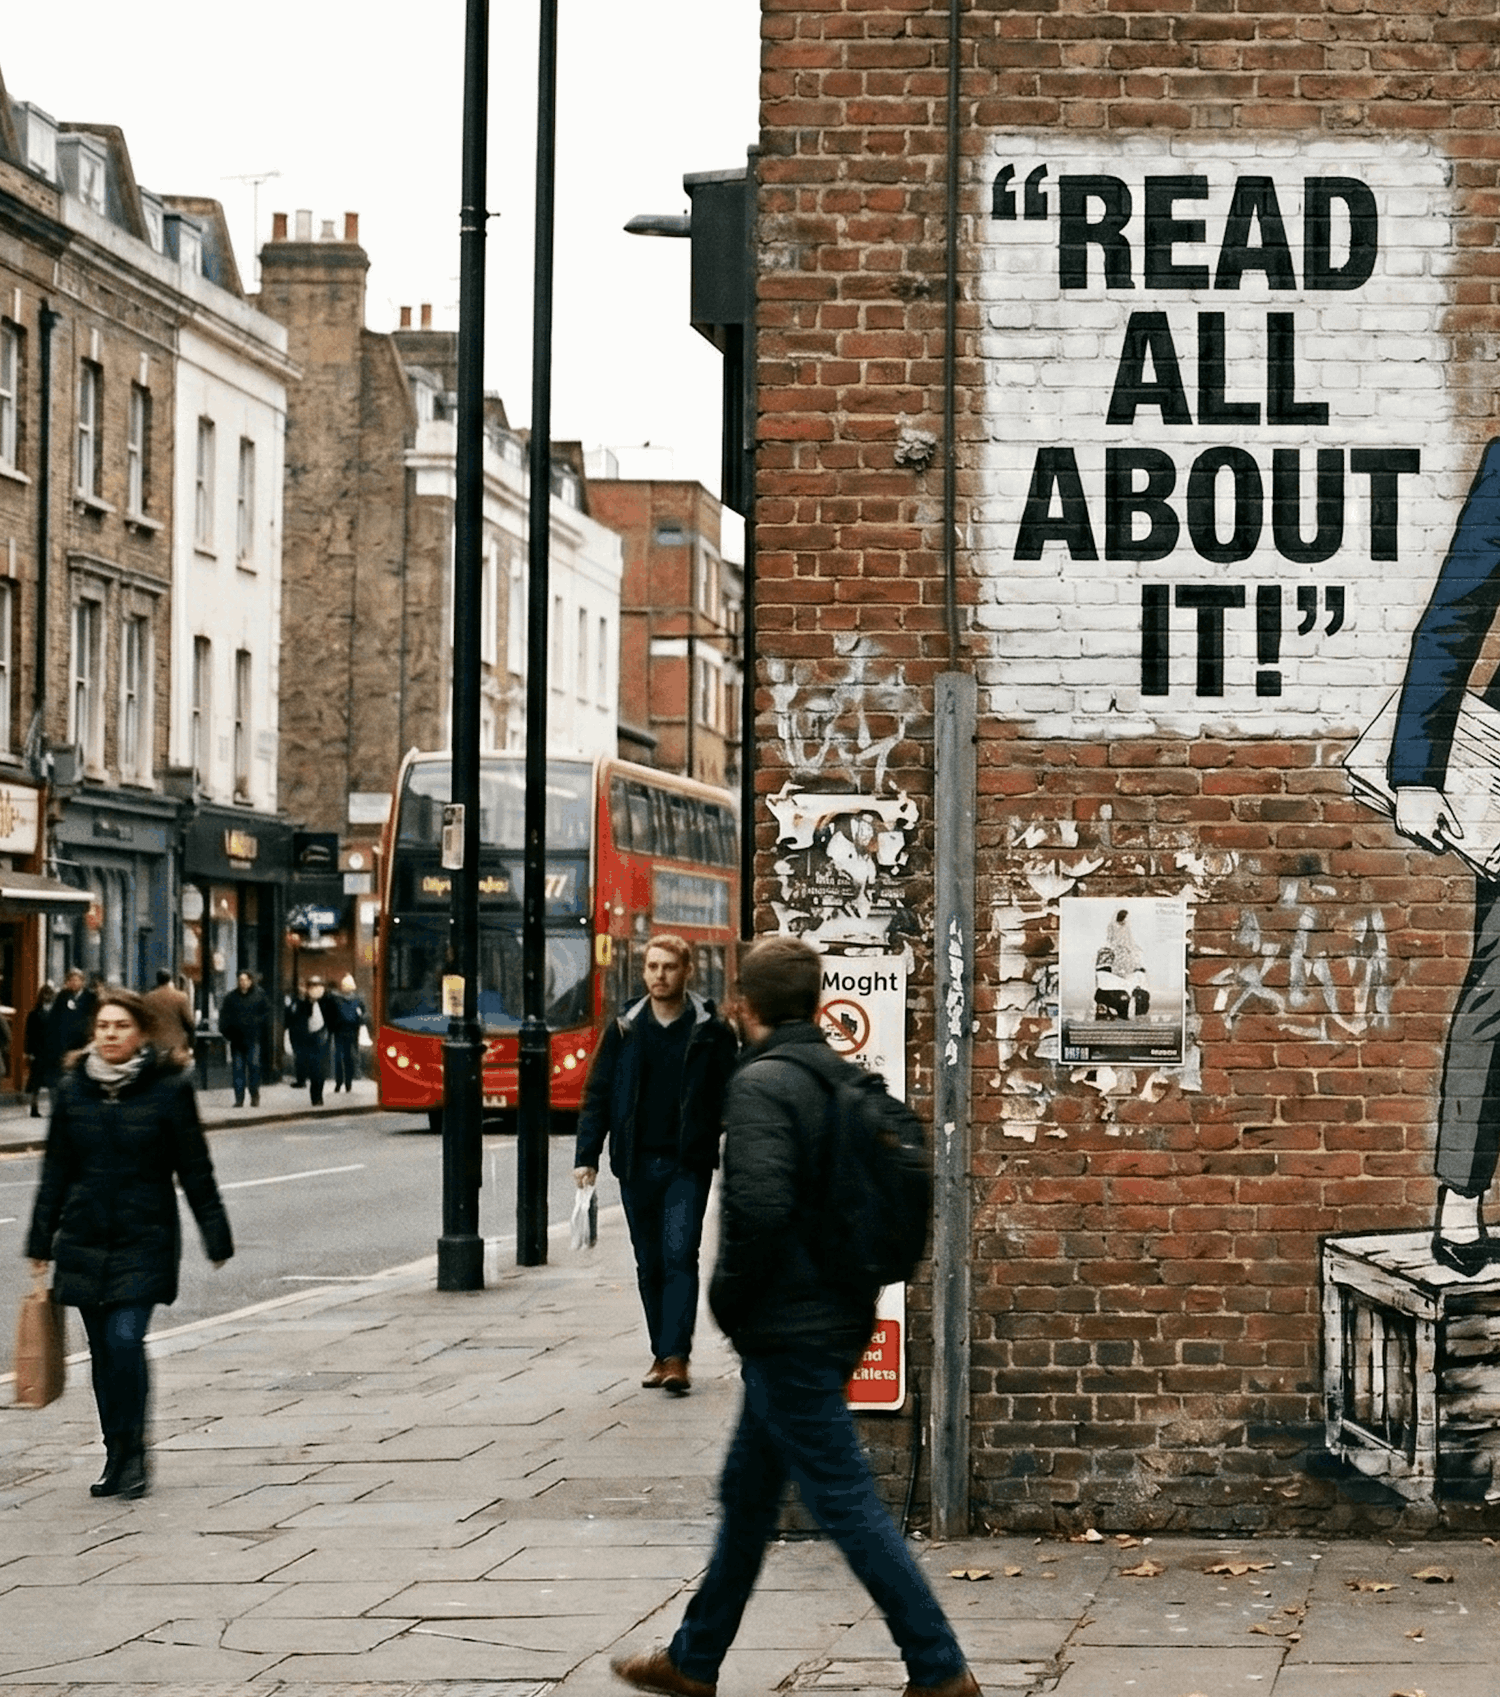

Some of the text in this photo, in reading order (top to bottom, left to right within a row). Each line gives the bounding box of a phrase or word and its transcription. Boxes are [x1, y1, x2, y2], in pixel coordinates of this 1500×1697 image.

[992, 163, 1378, 291] “READ
[1106, 311, 1330, 427] ALL
[1013, 446, 1421, 563] ABOUT
[822, 971, 899, 996] Moght
